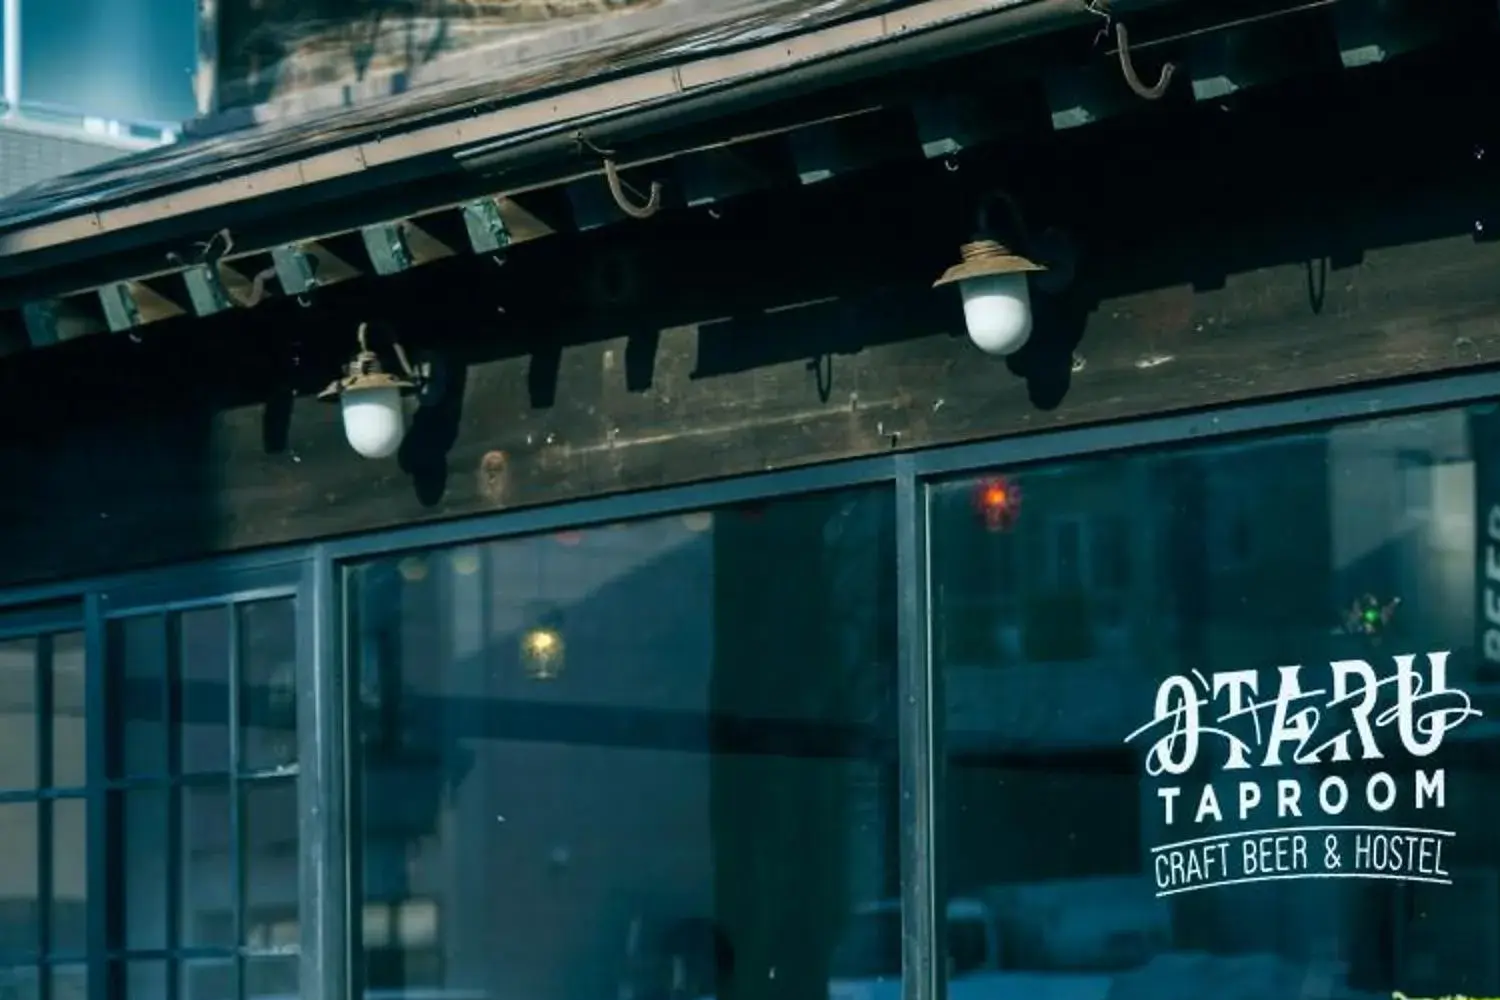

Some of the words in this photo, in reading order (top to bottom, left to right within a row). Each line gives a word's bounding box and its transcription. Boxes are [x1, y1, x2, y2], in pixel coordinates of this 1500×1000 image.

[1146, 651, 1453, 776] OTARU
[1157, 768, 1446, 825] TAPROOM
[1155, 842, 1231, 889] CRAFT
[1243, 834, 1308, 876] BEER
[1323, 834, 1342, 869] &
[1354, 833, 1450, 877] HOSTEL
